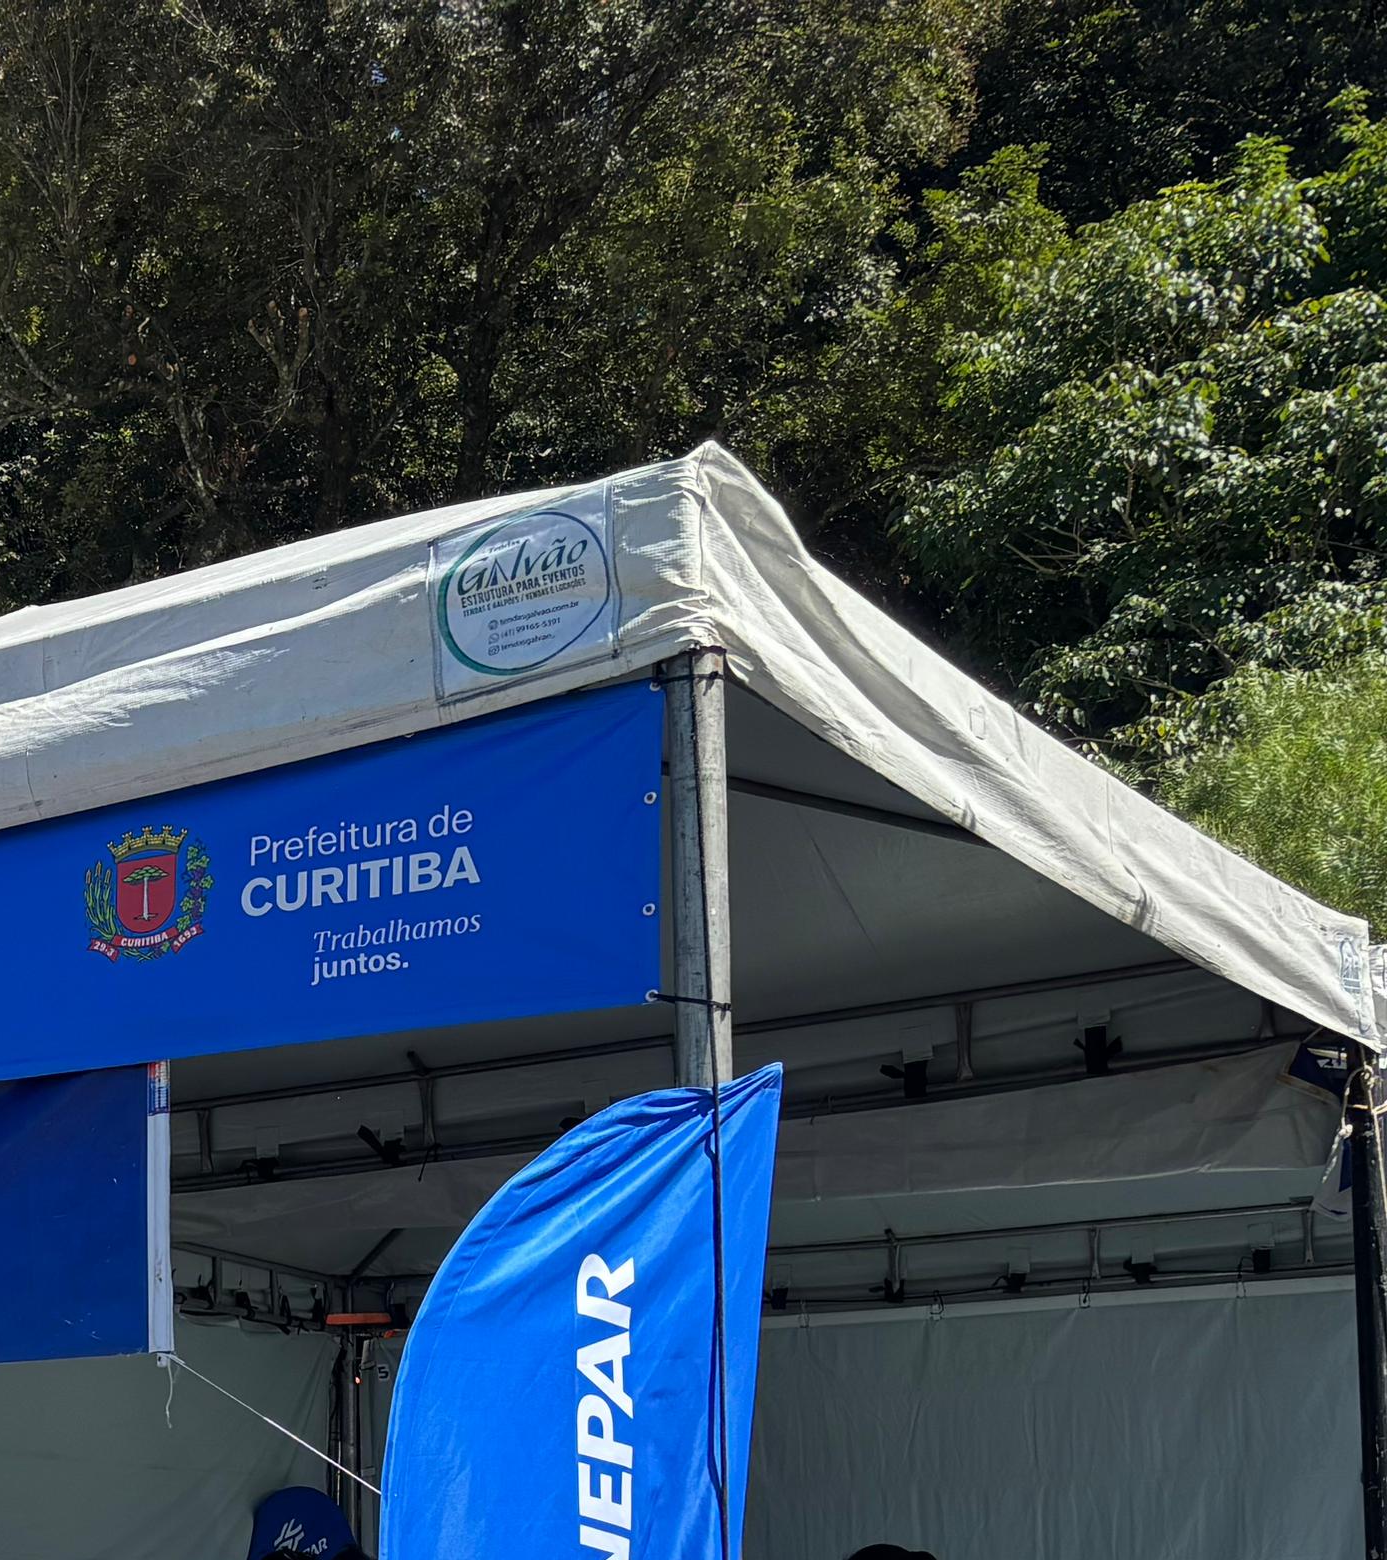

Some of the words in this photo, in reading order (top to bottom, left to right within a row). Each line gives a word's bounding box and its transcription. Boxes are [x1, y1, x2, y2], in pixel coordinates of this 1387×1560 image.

[460, 584, 516, 609] ESTRUTURA
[516, 577, 541, 593] PARA
[543, 564, 585, 587] EVENTOS
[250, 817, 418, 867] Prefeitura
[428, 804, 474, 838] de
[240, 845, 482, 918] CURITIBA
[120, 931, 169, 948] CURITIBA
[172, 925, 198, 948] 1693
[313, 913, 482, 953] Trabalhamos
[311, 951, 410, 986] juntos.
